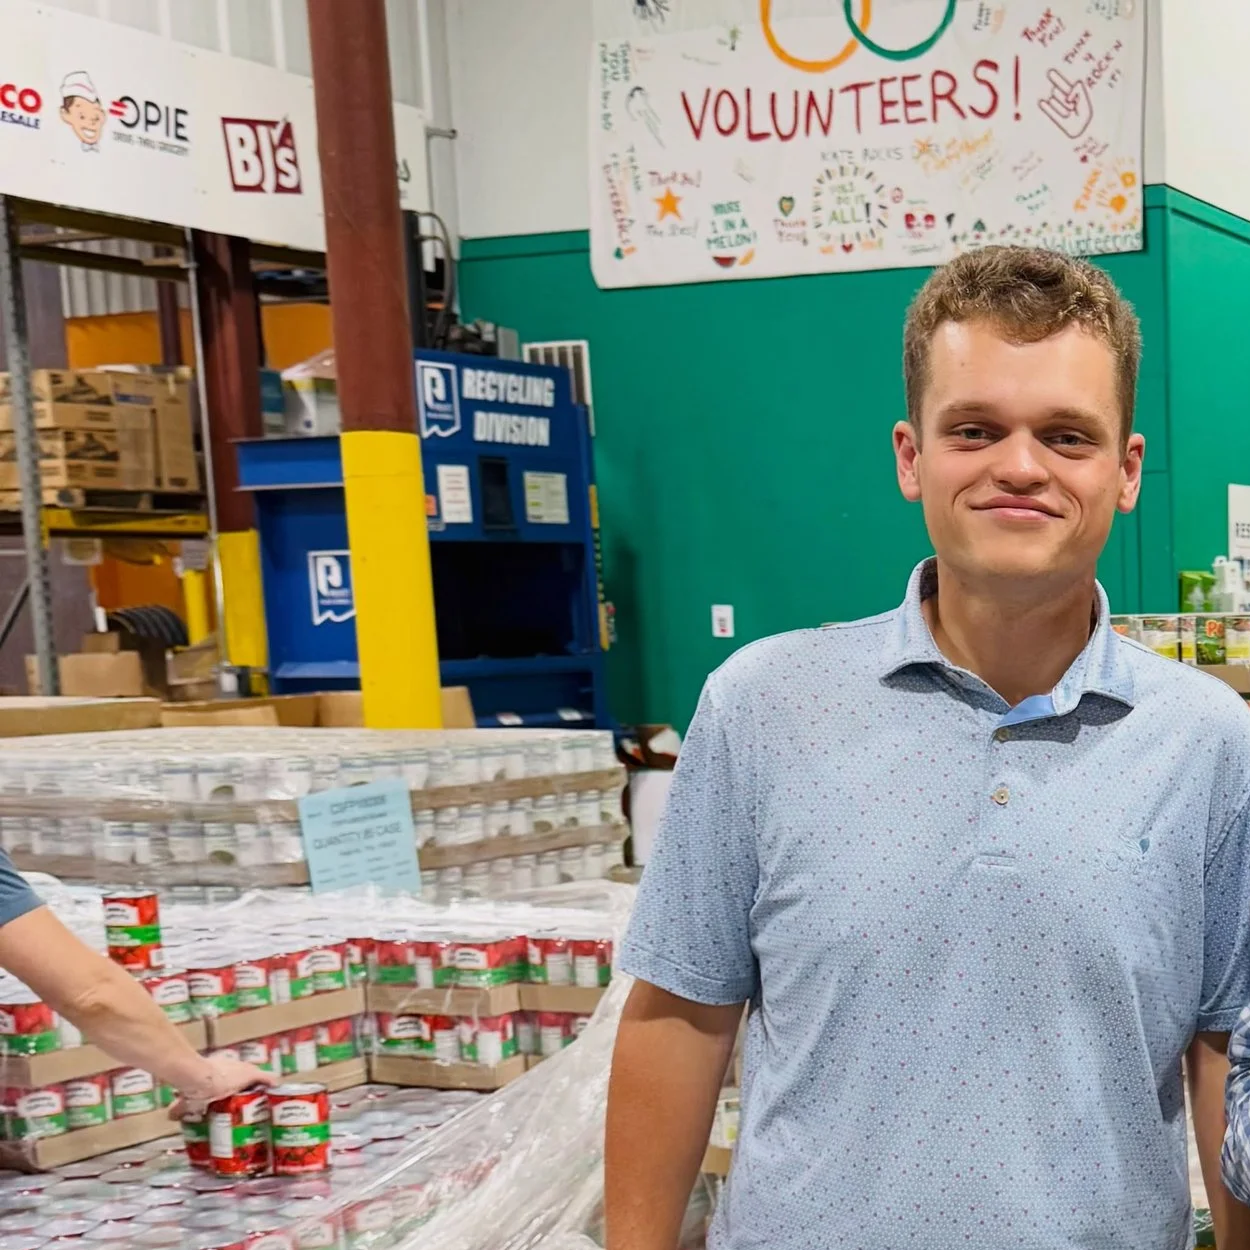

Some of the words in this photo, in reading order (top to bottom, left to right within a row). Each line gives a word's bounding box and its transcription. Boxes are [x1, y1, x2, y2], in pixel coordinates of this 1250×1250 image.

[681, 55, 1022, 141] VOLUNTEERS!
[829, 203, 872, 225] ALL!
[462, 368, 555, 407] RECYCLING
[473, 410, 550, 447] DIVISION
